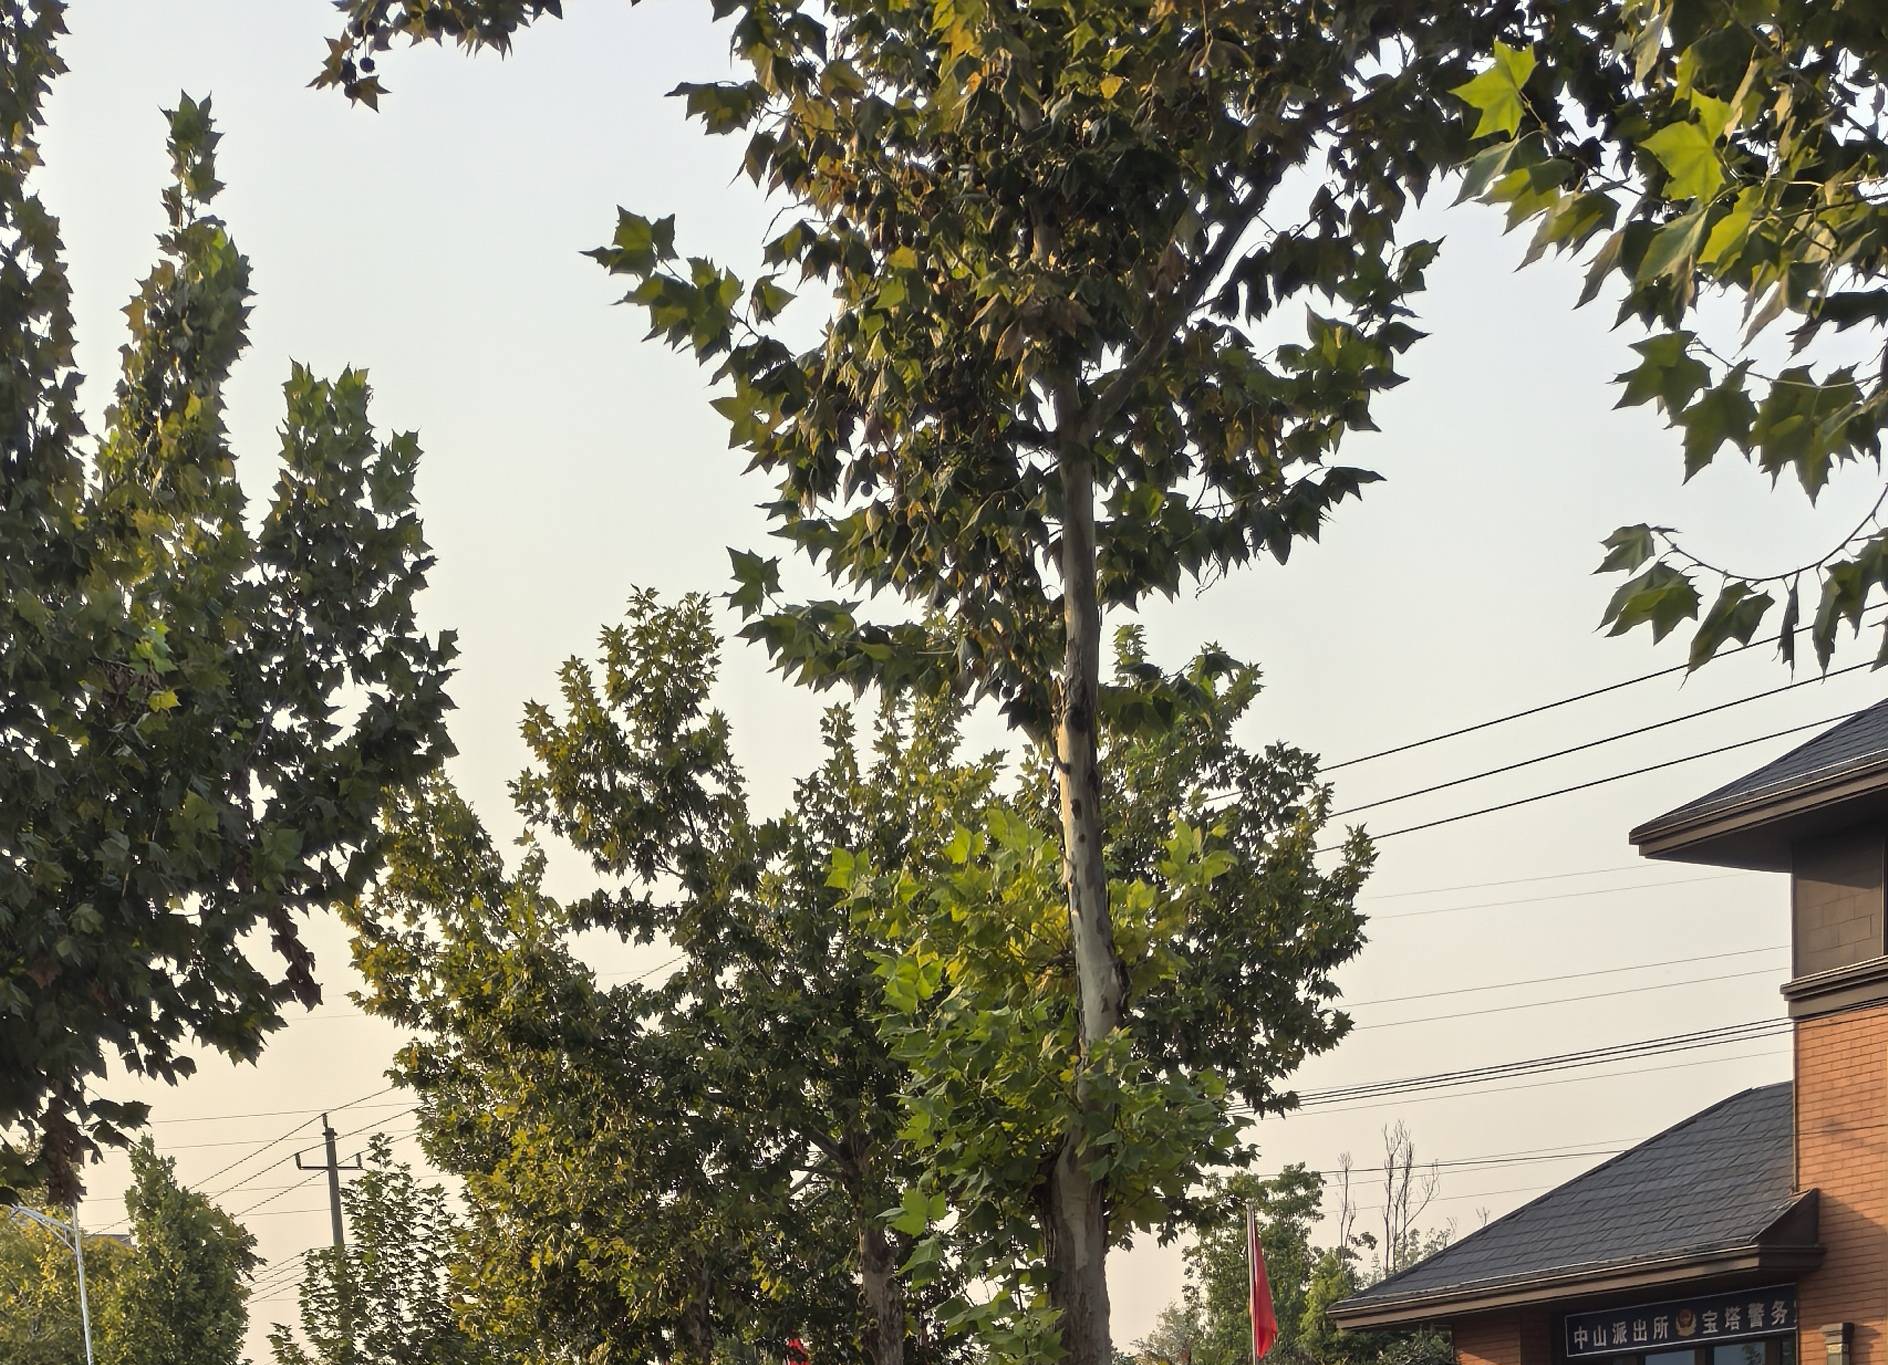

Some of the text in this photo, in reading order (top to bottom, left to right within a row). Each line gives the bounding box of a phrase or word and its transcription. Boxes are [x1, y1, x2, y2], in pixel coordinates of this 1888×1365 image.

[1573, 1300, 1797, 1350] 中山派出所 宝塔警务
